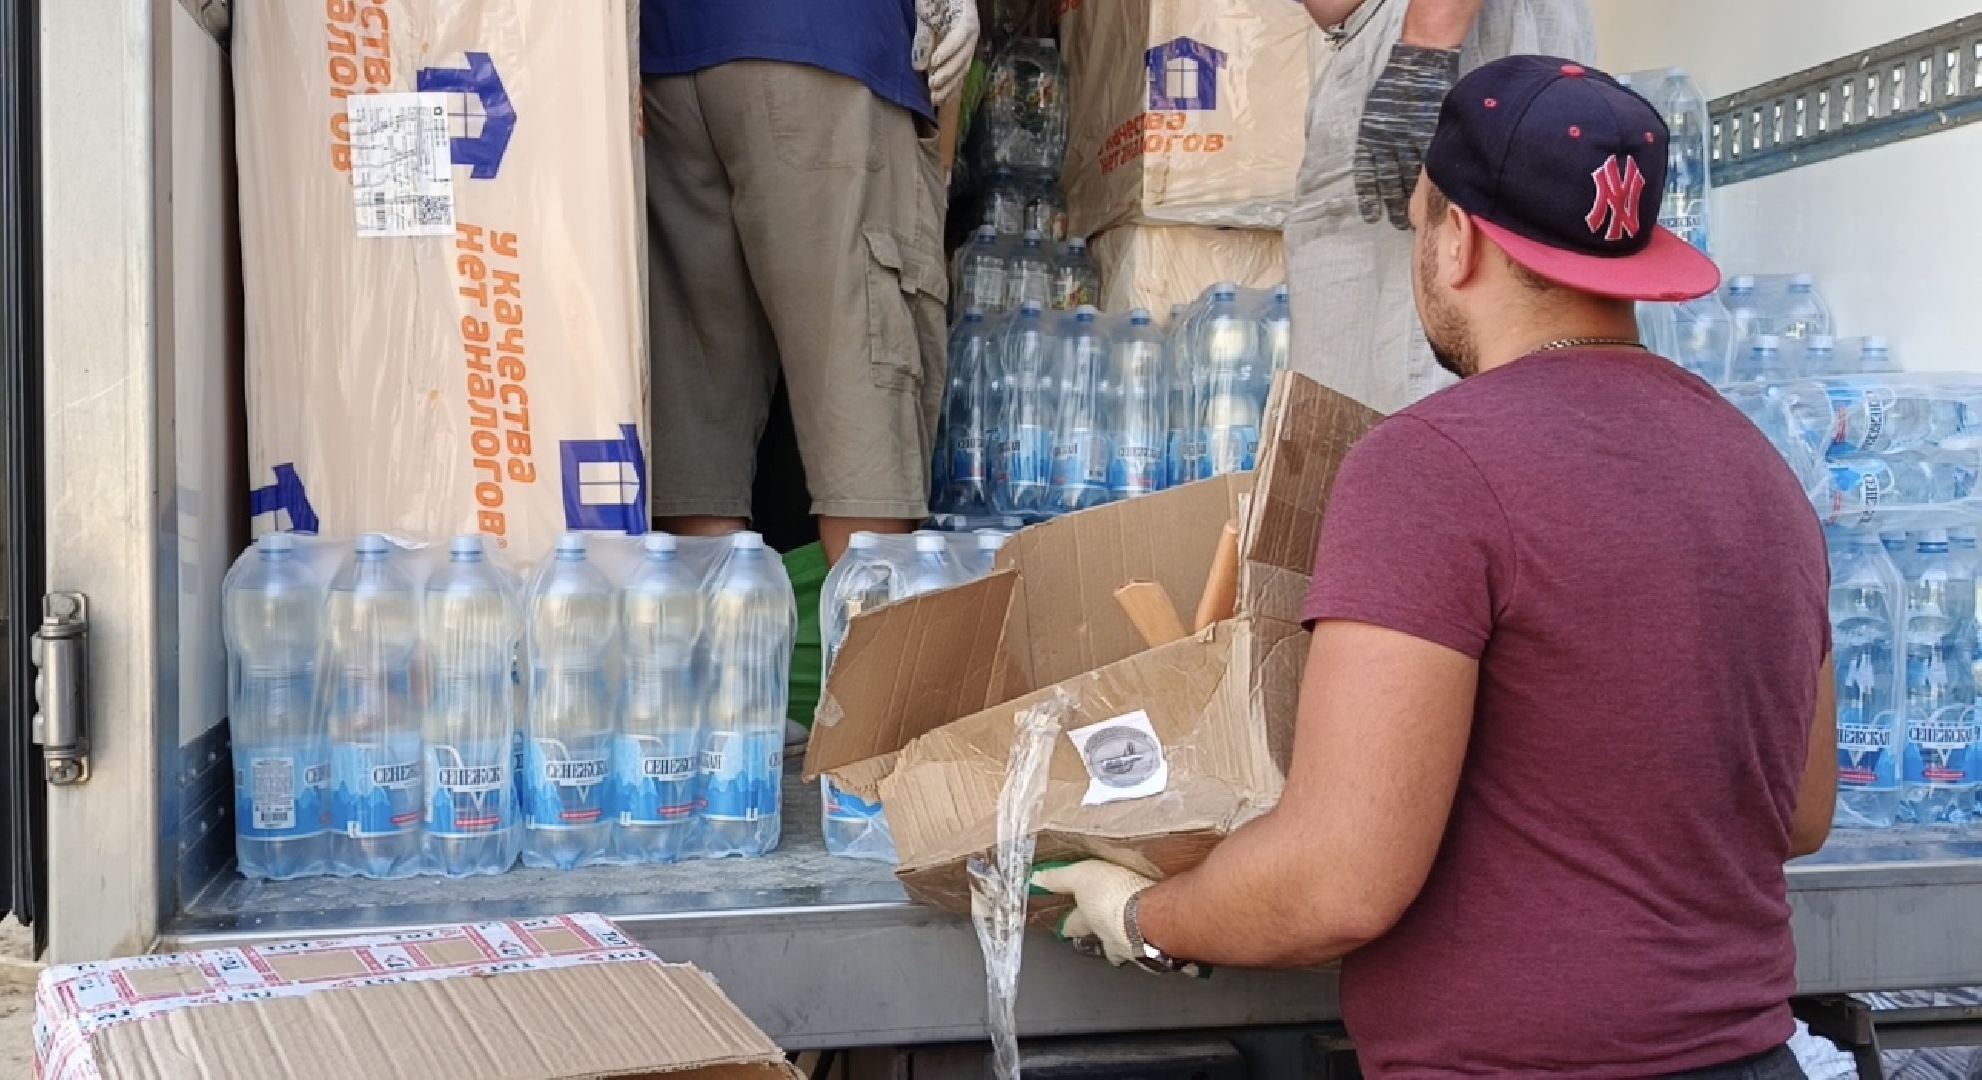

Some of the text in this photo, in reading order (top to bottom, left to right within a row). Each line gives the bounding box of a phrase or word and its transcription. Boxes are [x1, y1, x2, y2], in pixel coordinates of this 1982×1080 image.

[1585, 154, 1646, 241] NY
[455, 221, 507, 536] нет аналогов
[490, 229, 537, 485] у качества
